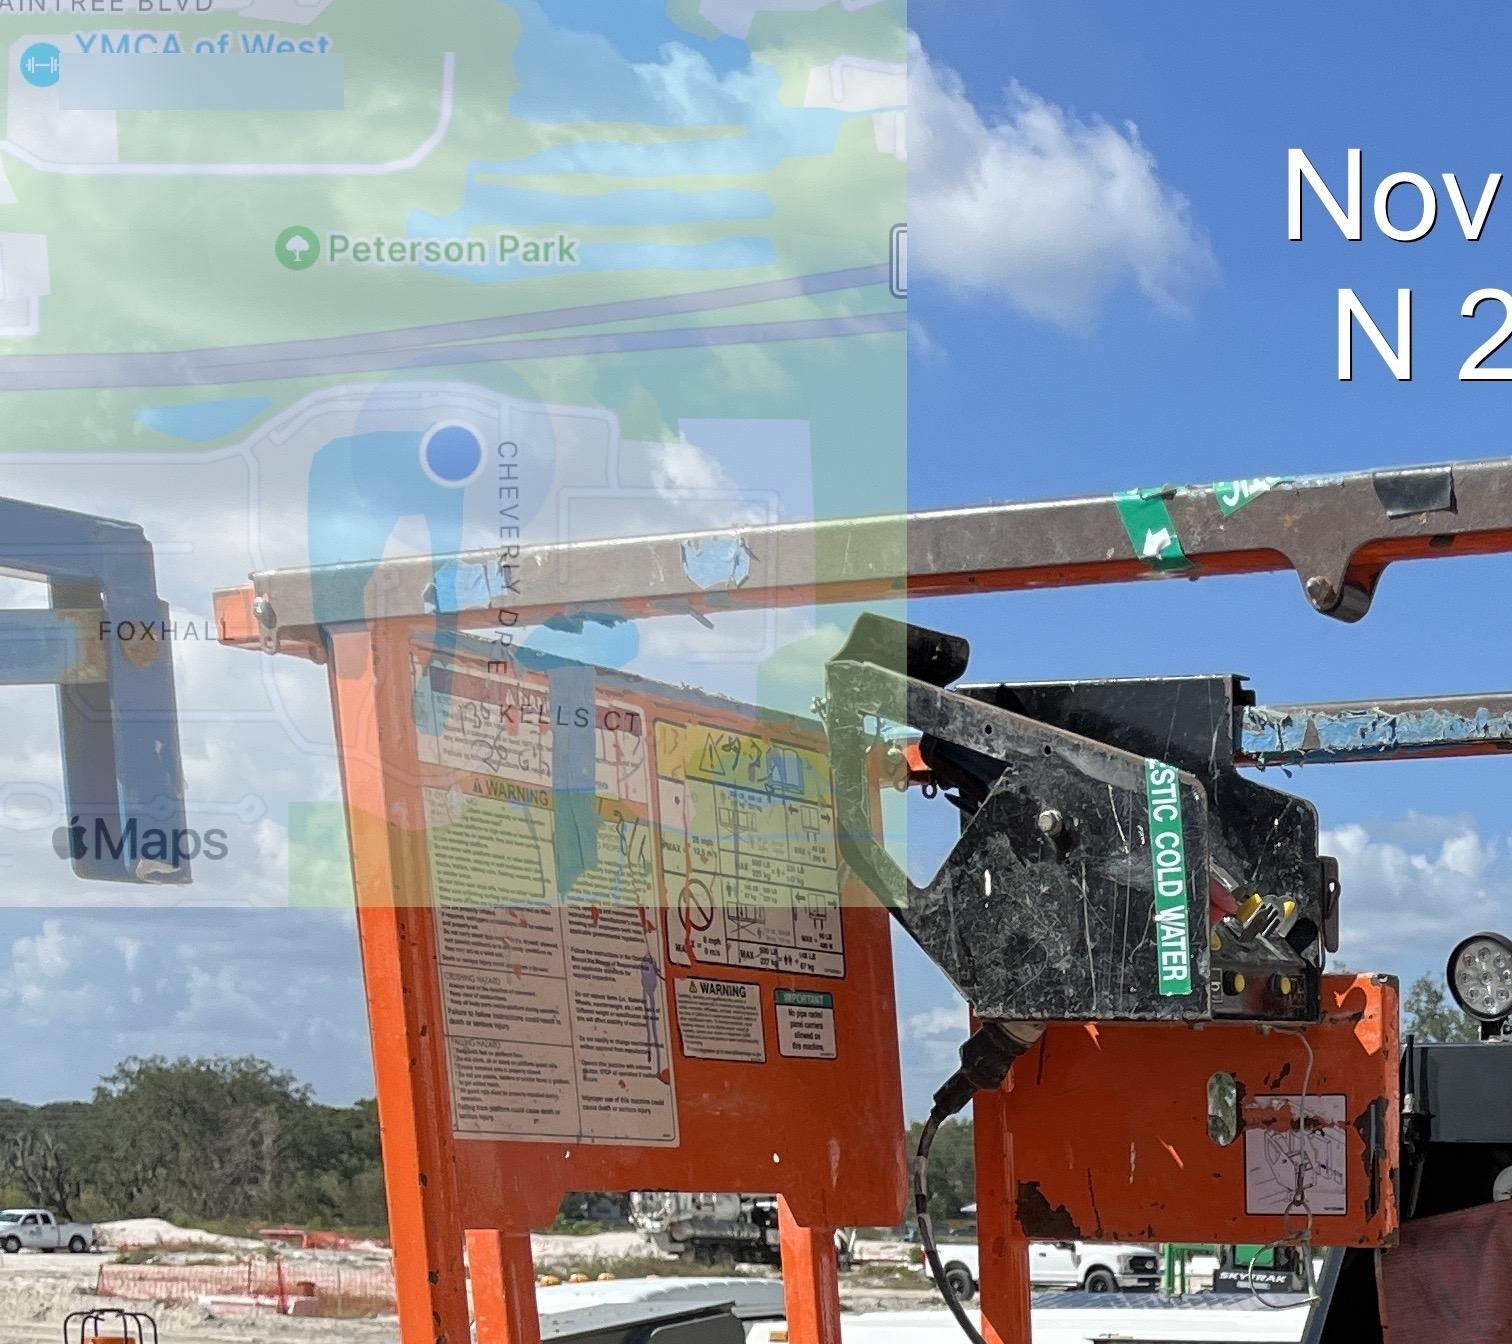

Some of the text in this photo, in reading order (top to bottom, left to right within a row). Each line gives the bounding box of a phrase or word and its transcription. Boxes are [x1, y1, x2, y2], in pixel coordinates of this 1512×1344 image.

[487, 777, 550, 807] WARNING
[1154, 831, 1183, 898] COLD
[1158, 904, 1189, 982] WATER
[699, 981, 747, 999] WARNING
[1219, 1271, 1288, 1284] SKYTRAK
